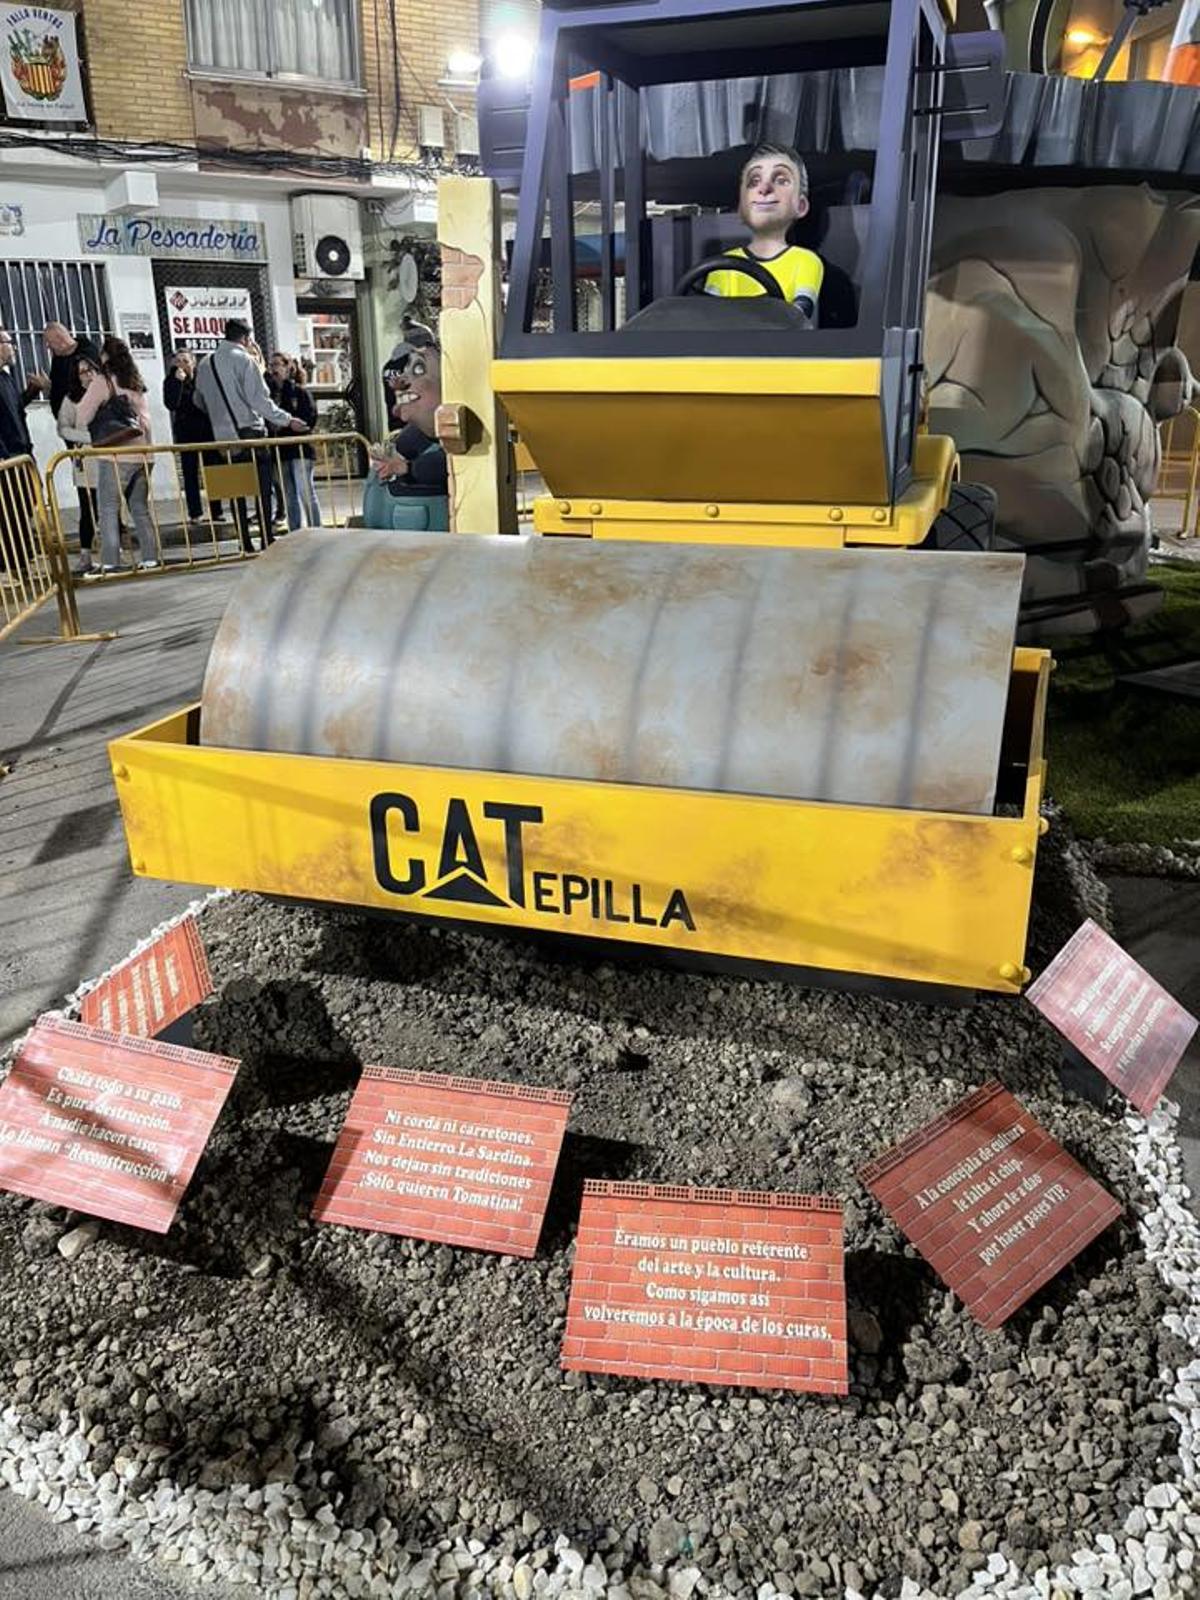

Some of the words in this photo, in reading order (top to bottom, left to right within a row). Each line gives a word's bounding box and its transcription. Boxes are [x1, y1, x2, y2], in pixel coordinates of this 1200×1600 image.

[87, 219, 120, 247] La
[128, 219, 261, 251] Pescadería
[173, 317, 191, 334] SE
[47, 1088, 62, 1104] Es
[64, 1092, 92, 1110] pura
[95, 1100, 172, 1131] destrucción.
[95, 1078, 123, 1096] todo
[124, 1085, 133, 1096] a
[135, 1087, 149, 1099] su
[152, 1090, 182, 1110] paso.
[0, 1126, 15, 1141] Lo
[16, 1128, 61, 1154] llaman
[50, 1115, 87, 1134] nadie
[91, 1122, 124, 1145] hacen
[128, 1135, 159, 1153] caso.
[385, 1109, 400, 1126] Ni
[443, 1118, 457, 1132] ni
[459, 1122, 536, 1146] carretones.
[373, 1129, 396, 1145] Sin
[399, 1132, 456, 1155] Entierro
[458, 1141, 475, 1157] La
[476, 1145, 535, 1167] Sardina.
[914, 1195, 928, 1209] A
[925, 1187, 938, 1203] la
[937, 1157, 982, 1195] concejala
[978, 1146, 994, 1161] de
[991, 1124, 1027, 1152] cultura
[364, 1149, 389, 1166] Nos
[392, 1155, 428, 1175] dejan
[431, 1162, 451, 1176] sin
[454, 1163, 533, 1190] tradiciones
[952, 1197, 969, 1213] le
[965, 1176, 994, 1205] falta
[989, 1171, 1002, 1186] el
[997, 1158, 1025, 1181] chip.
[396, 1178, 449, 1200] quieren
[452, 1185, 524, 1212] Tomatina!
[968, 1219, 982, 1233] Y
[979, 1196, 1010, 1227] ahora
[1007, 1191, 1019, 1208] le
[1016, 1186, 1027, 1197] a
[978, 1244, 1001, 1266] por
[996, 1220, 1027, 1249] hacer
[1022, 1201, 1052, 1229] pases
[1045, 1182, 1070, 1212] VIP.
[670, 1239, 687, 1250] un
[690, 1236, 739, 1255] pueblo
[741, 1241, 808, 1260] referente
[637, 1256, 659, 1272] del
[662, 1261, 693, 1275] arte
[693, 1264, 703, 1279] y
[706, 1261, 720, 1278] la
[723, 1264, 781, 1282] cultura.
[646, 1282, 686, 1299] Como
[690, 1286, 747, 1307] sigamos
[584, 1303, 665, 1327] volveremos
[667, 1313, 677, 1326] a
[679, 1311, 693, 1328] la
[696, 1311, 739, 1333] época
[741, 1316, 760, 1333] de
[762, 1316, 783, 1334] los
[785, 1322, 833, 1341] curas.
